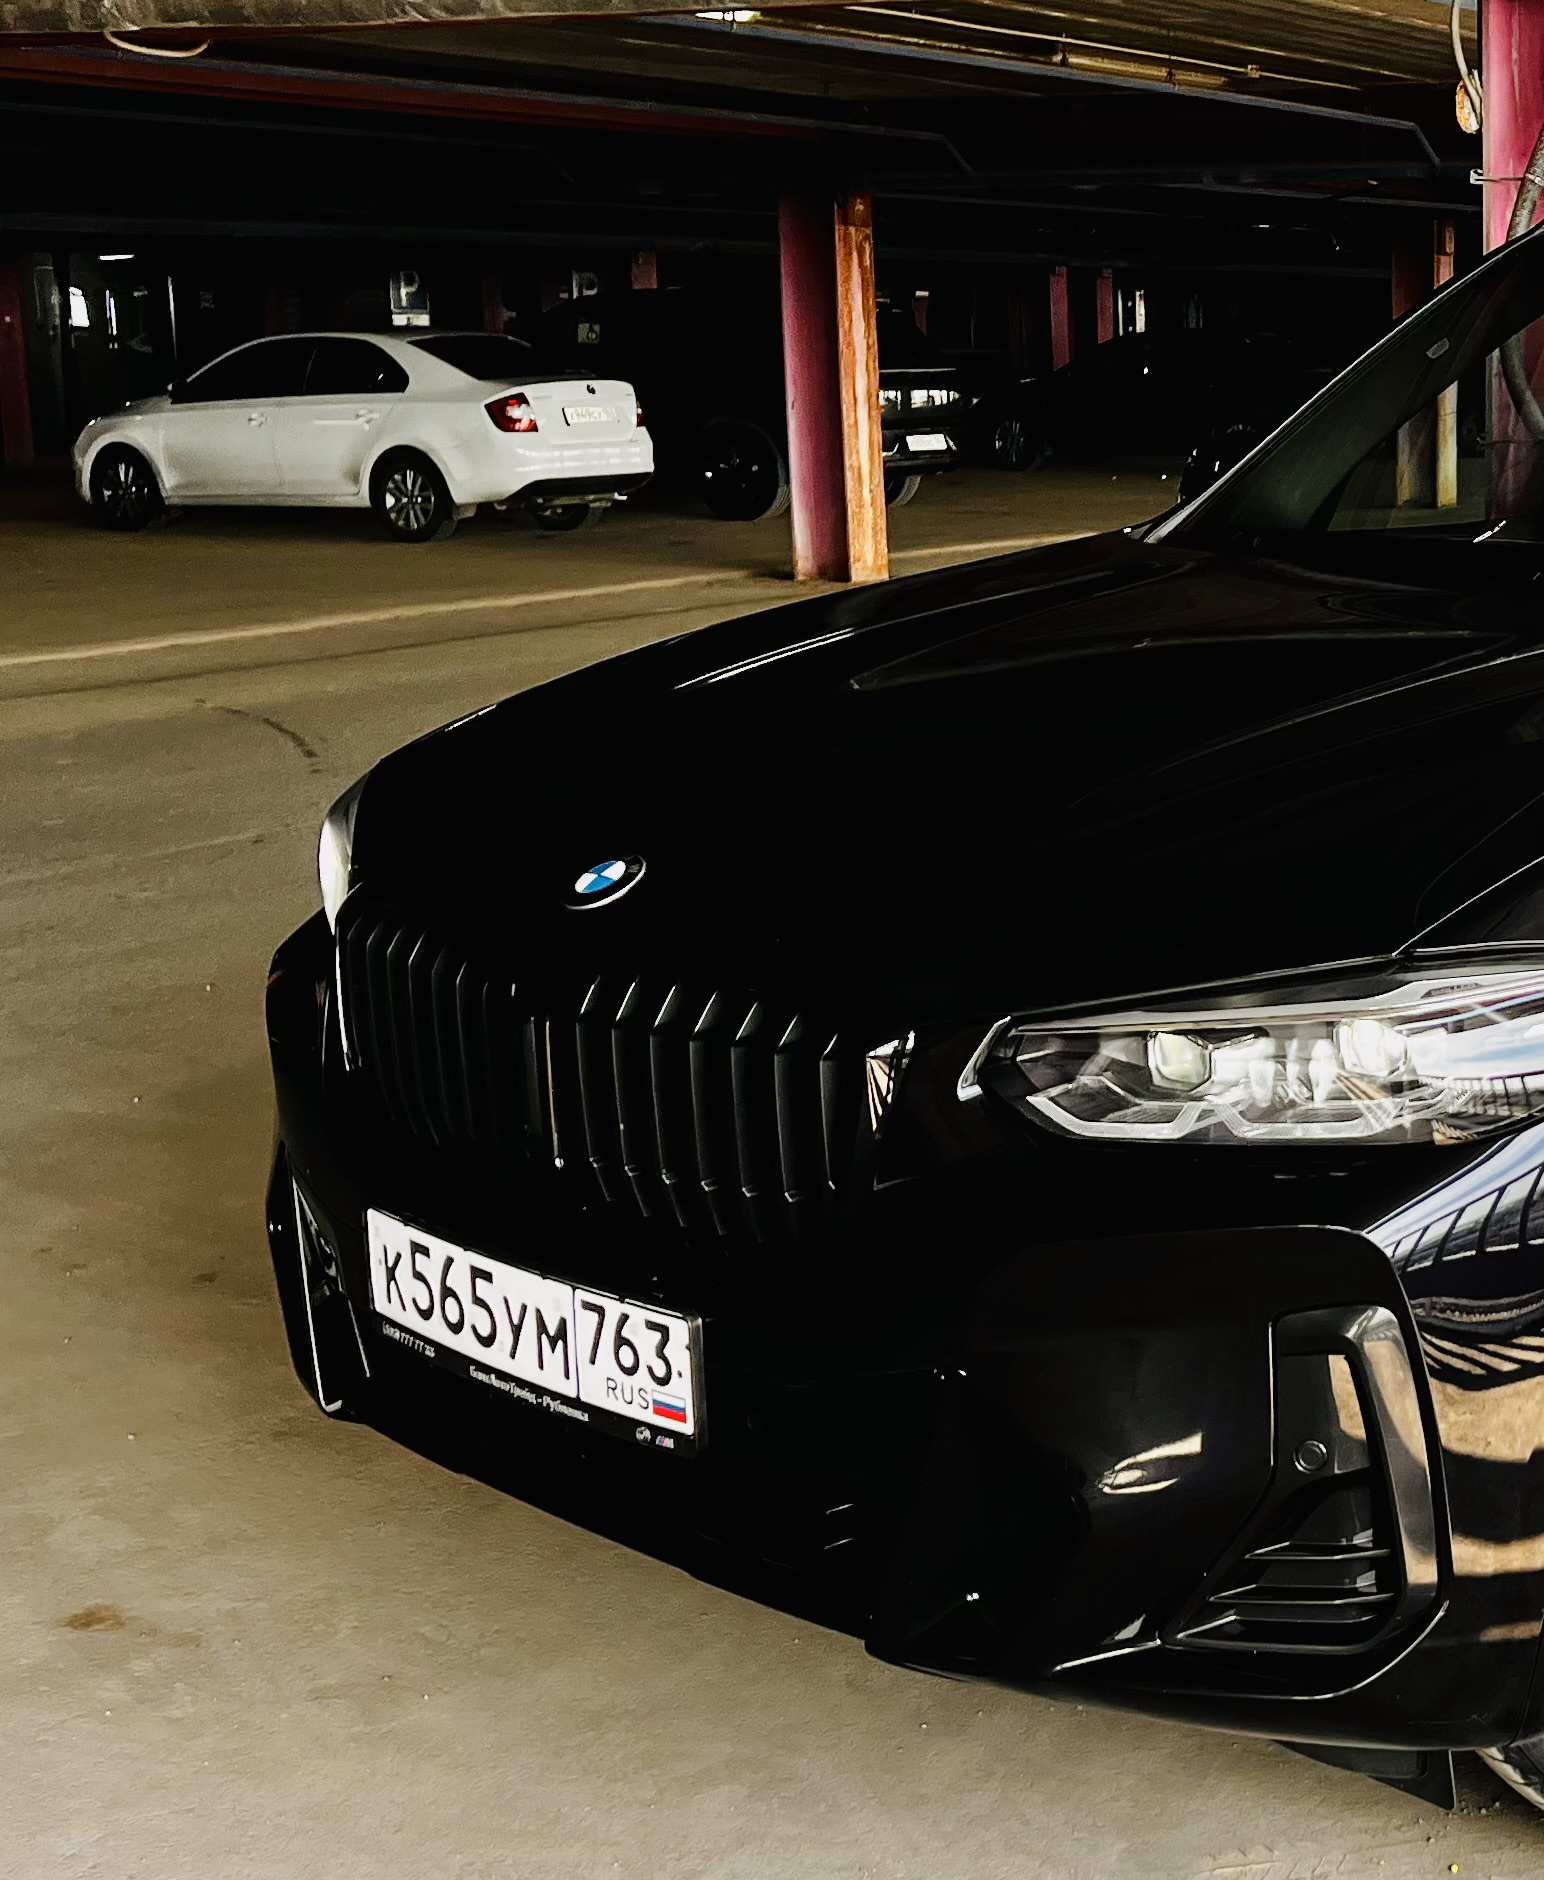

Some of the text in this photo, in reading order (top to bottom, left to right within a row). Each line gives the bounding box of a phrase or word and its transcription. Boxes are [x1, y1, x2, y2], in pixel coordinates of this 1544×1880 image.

[400, 270, 419, 307] P
[383, 1239, 672, 1387] К565УМ 763
[606, 1376, 650, 1410] RUS
